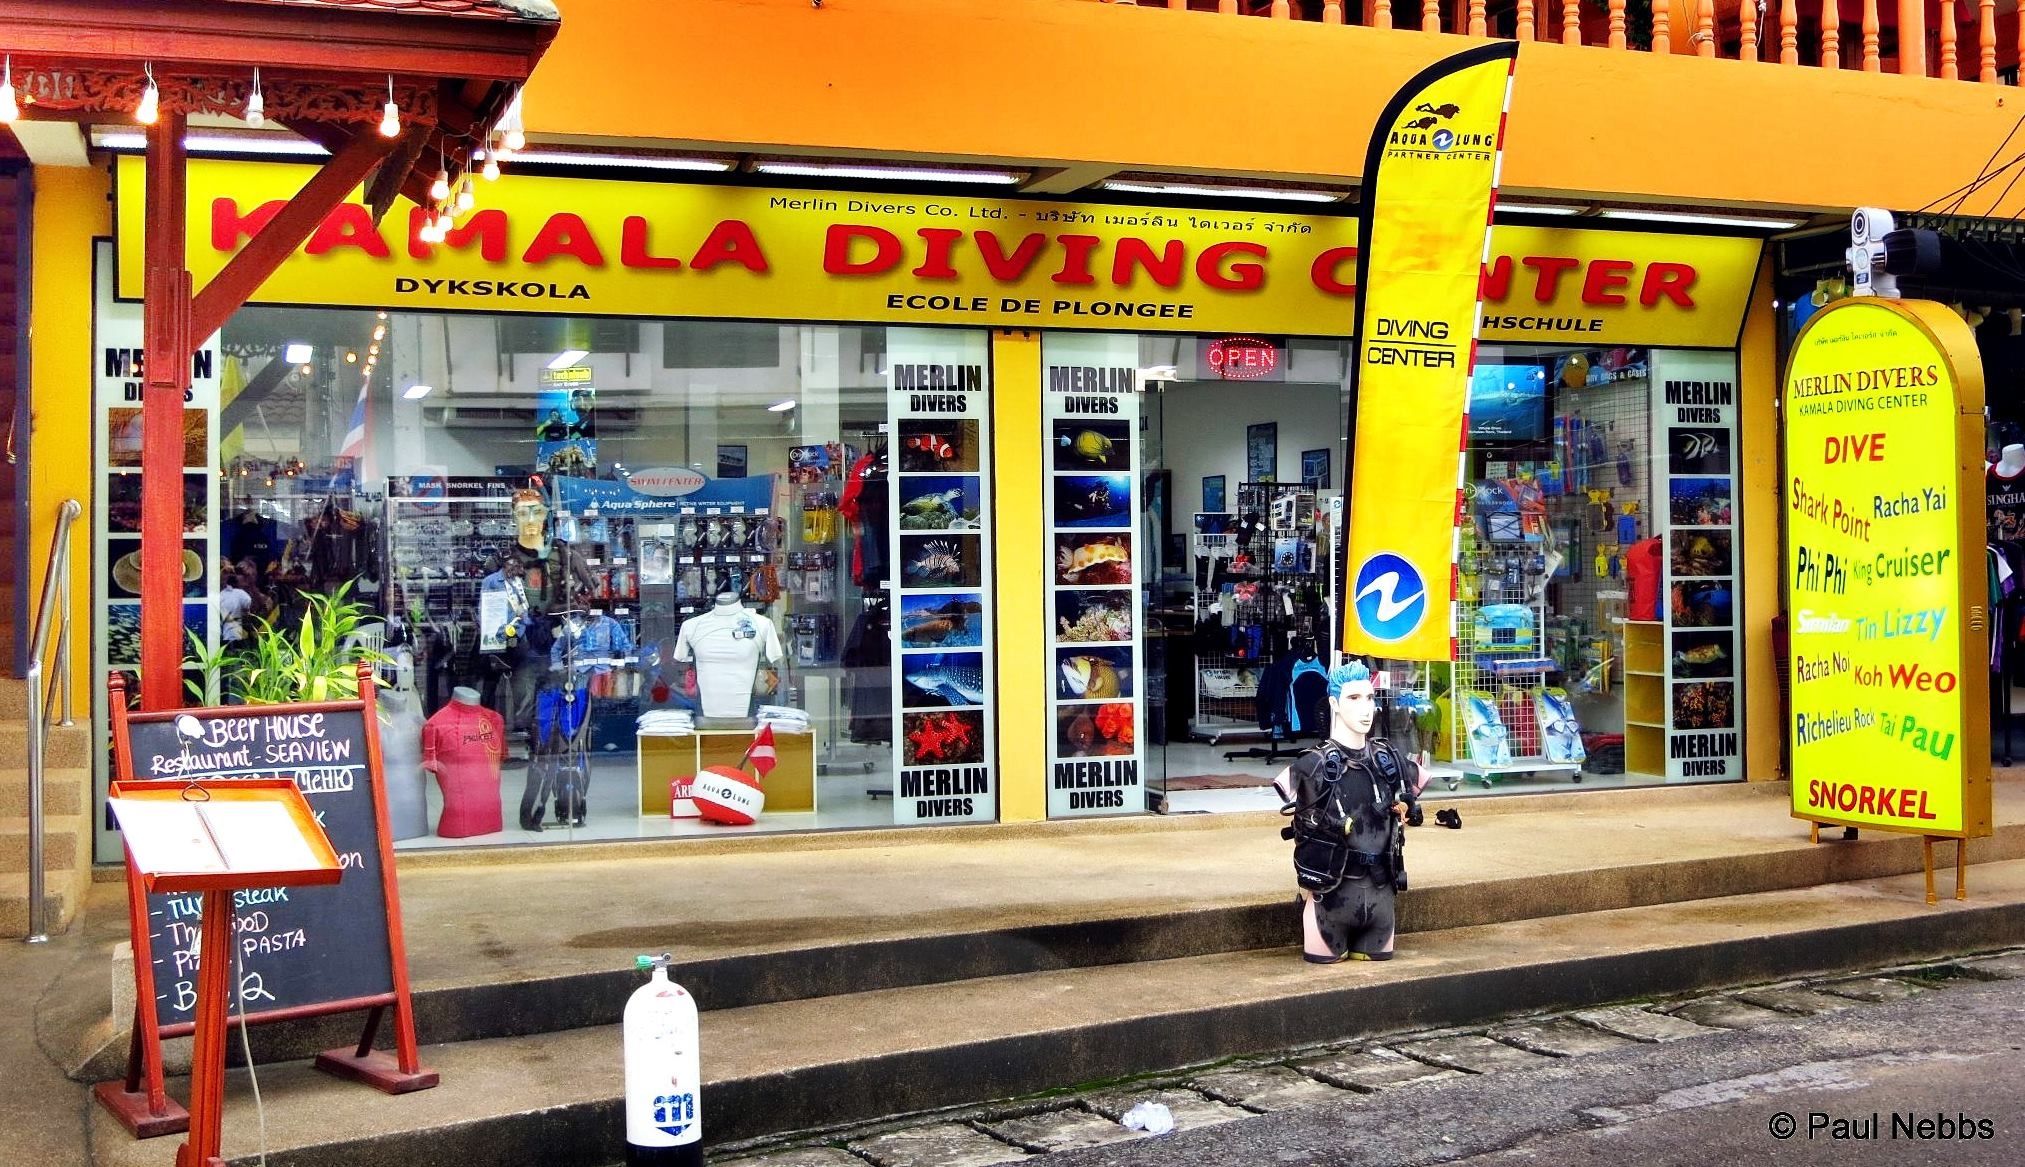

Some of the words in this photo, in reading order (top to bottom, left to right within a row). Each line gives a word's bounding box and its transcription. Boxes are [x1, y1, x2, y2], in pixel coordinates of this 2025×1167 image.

[1390, 131, 1427, 146] AQUA
[1456, 133, 1492, 147] LUNG
[1388, 151, 1440, 160] PARTNER
[1446, 152, 1491, 161] CENTER
[769, 197, 838, 211] Merlin
[848, 200, 916, 215] Divers
[925, 204, 958, 217] Co.
[969, 206, 1008, 219] Ltd.
[1036, 209, 1095, 224] บริษัท
[1264, 220, 1312, 235] จำกัด
[212, 197, 769, 272] KAMALA
[822, 223, 1268, 292] DIVING
[395, 277, 591, 299] DYKSKOLA
[886, 294, 988, 312] ECOLE
[1001, 298, 1041, 314] DE
[1053, 300, 1194, 319] PLONGEE
[1377, 318, 1449, 339] DIVING
[1208, 348, 1275, 367] OPEN
[1367, 346, 1455, 368] CENTER
[894, 364, 982, 391] MERLIN
[1049, 365, 1133, 393] MERLIN
[1793, 371, 1853, 399] MERLIN
[1857, 364, 1939, 392] DIVERS
[910, 394, 967, 413] DIVERS
[1064, 396, 1119, 414] DIVERS
[1665, 380, 1732, 406] MERLIN
[1799, 399, 1834, 417] KAMALA
[1836, 397, 1875, 413] DIVING
[1878, 393, 1928, 409] CENTER
[1677, 407, 1721, 424] DIVERS
[1824, 433, 1886, 465] DIVE
[602, 500, 632, 509] Aqua
[633, 500, 676, 510] Sphere
[1792, 477, 1829, 526] Shark
[1832, 498, 1871, 543] Point
[1873, 491, 1919, 520] Racha
[1922, 485, 1946, 510] Yai
[1987, 492, 2025, 506] SINGHA
[1796, 545, 1821, 592] Phi
[1823, 553, 1848, 595] Phi
[1853, 560, 1873, 586] King
[1875, 547, 1951, 579] Cruiser
[1856, 616, 1878, 641] Tin
[1884, 606, 1948, 642] Lizzy
[1797, 653, 1830, 684] Racha
[1833, 650, 1851, 675] Noi
[1854, 665, 1883, 687] Koh
[1888, 663, 1956, 694] Weo
[1796, 709, 1852, 747] Richelieu
[1854, 707, 1876, 730] Rock
[1880, 712, 1898, 738] Tai
[1900, 715, 1955, 761] Pau
[150, 747, 253, 776] Restaurant
[265, 739, 351, 764] SEAVIEW
[1670, 732, 1737, 759] MERLIN
[1054, 760, 1138, 790] MERLIN
[1682, 759, 1726, 777] DIVERS
[900, 767, 988, 798] MERLIN
[916, 798, 974, 818] DIVERS
[1069, 789, 1124, 810] DIVERS
[1808, 779, 1937, 820] SNORKEL
[243, 928, 307, 957] PASTA
